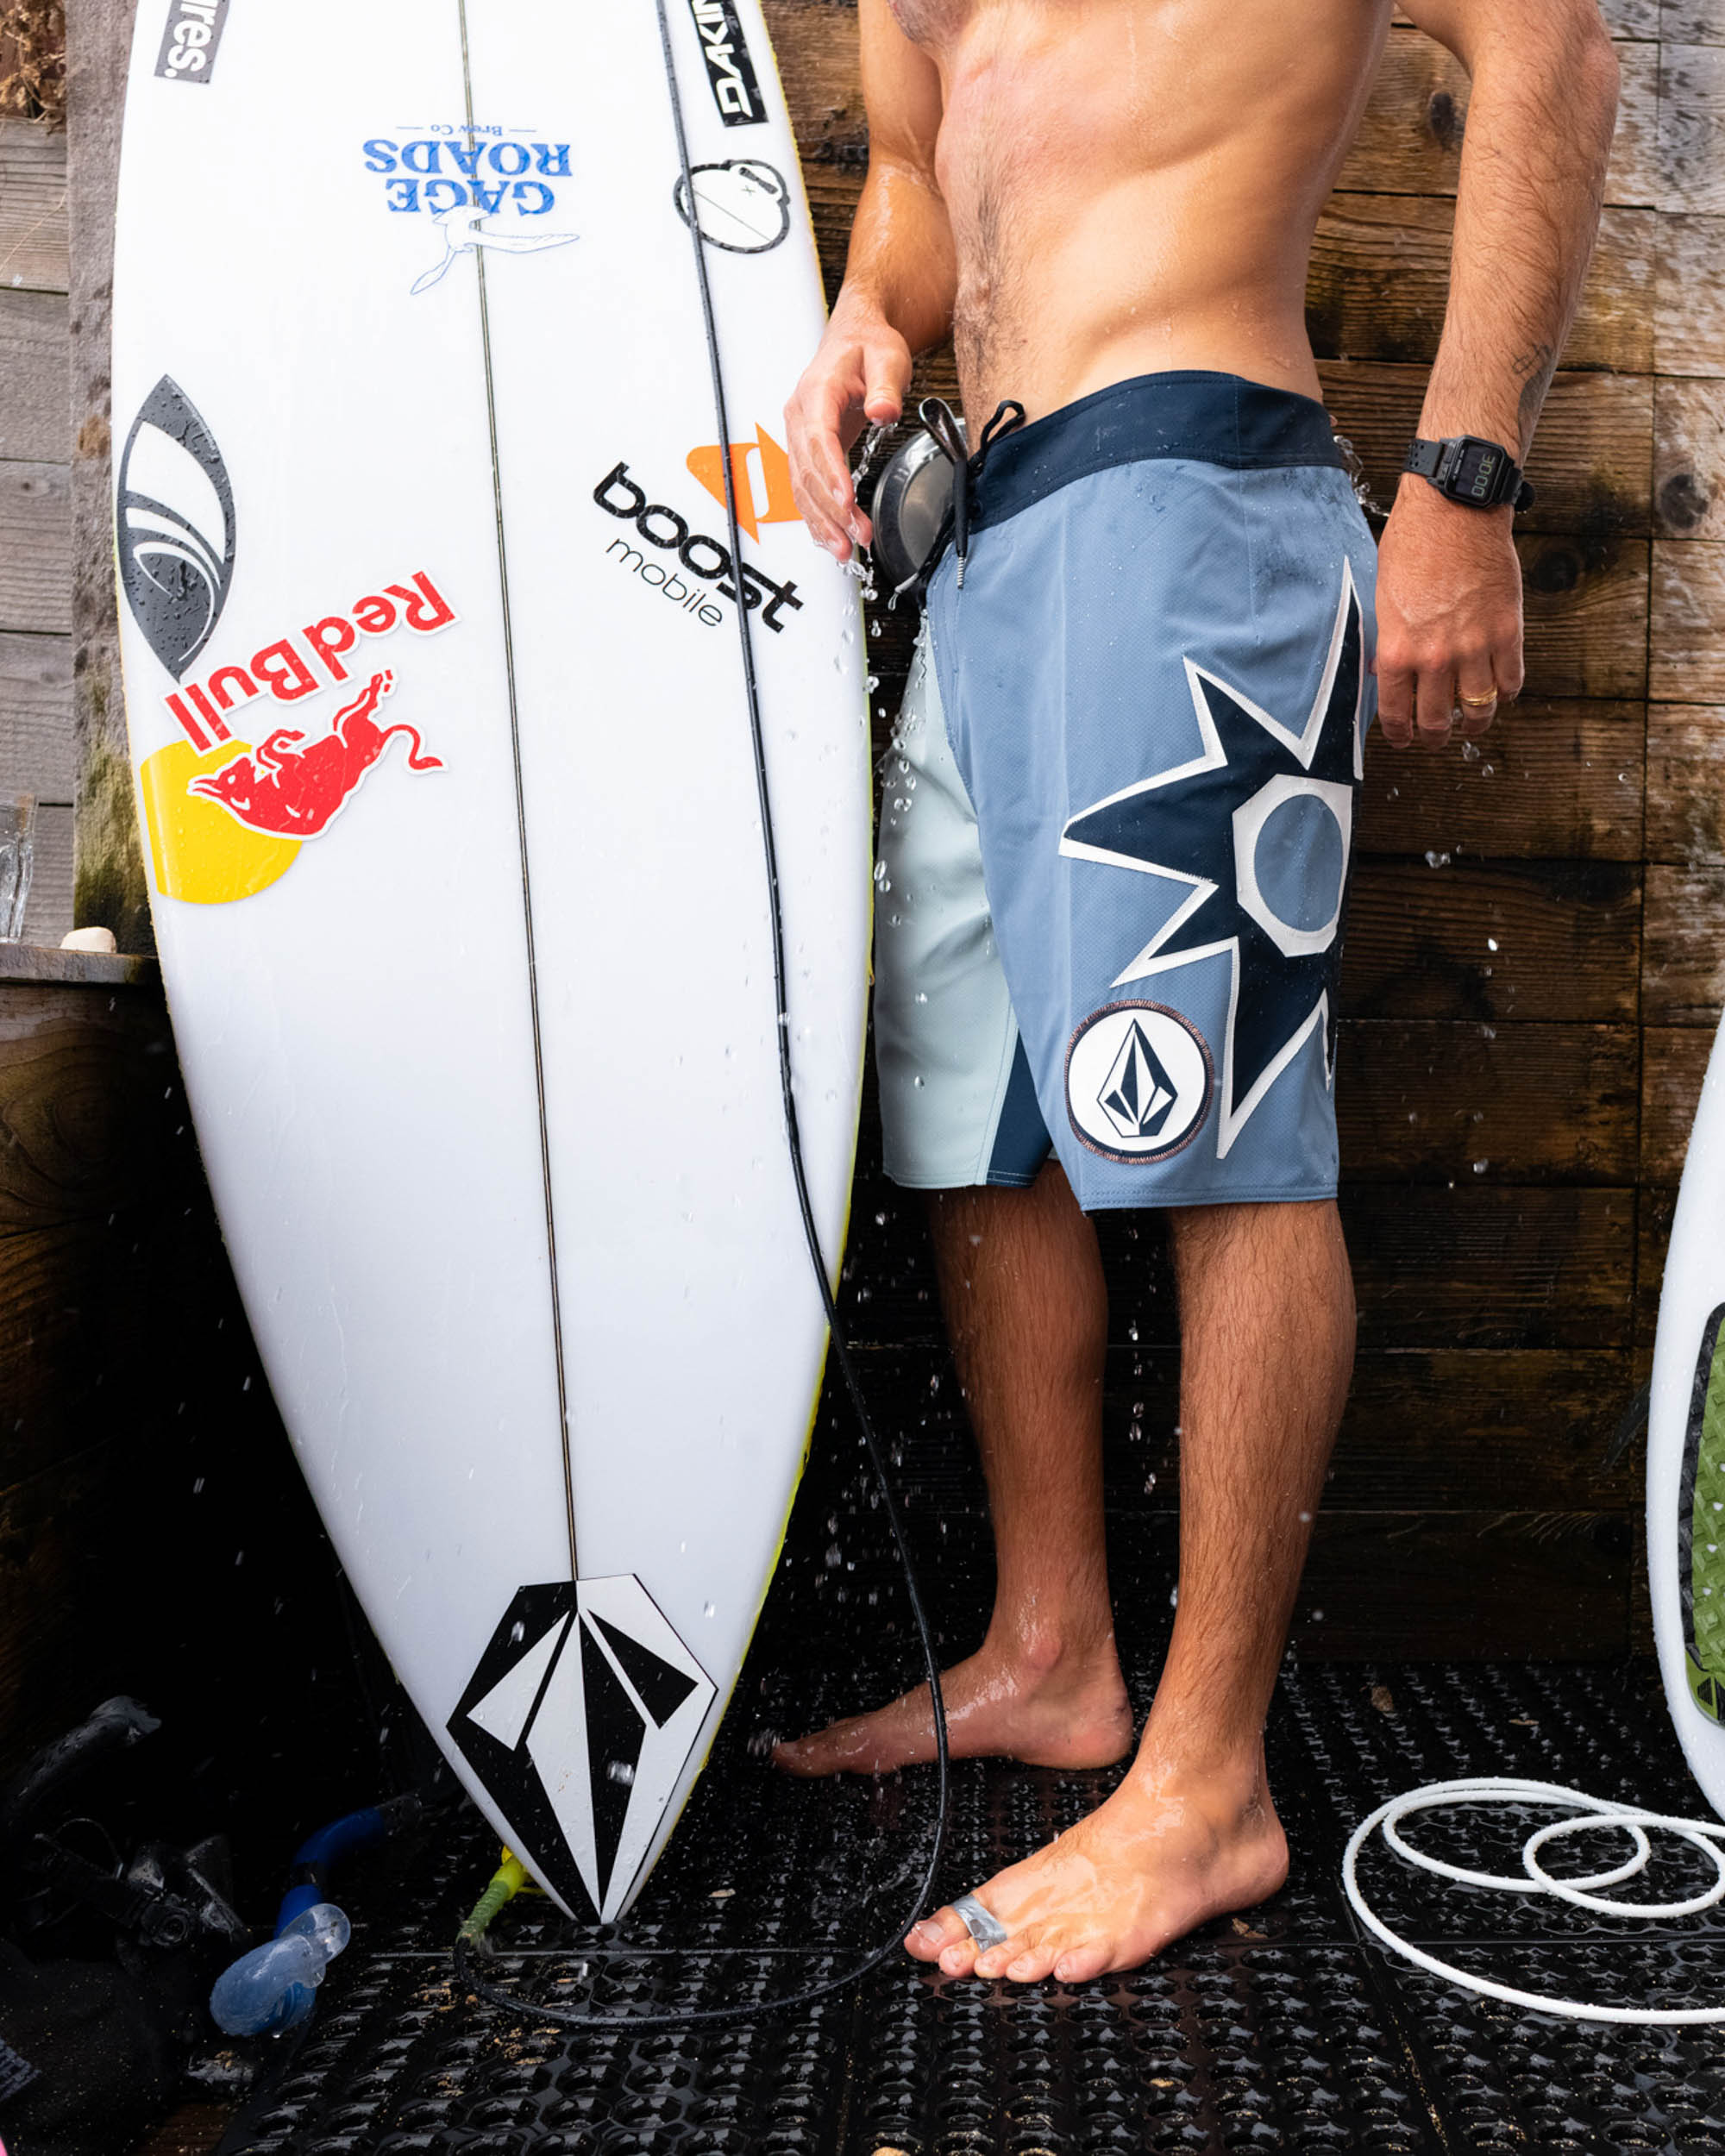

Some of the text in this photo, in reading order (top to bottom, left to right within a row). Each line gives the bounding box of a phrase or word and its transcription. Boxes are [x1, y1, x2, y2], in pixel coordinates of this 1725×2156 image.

[430, 124, 503, 137] Brew Co
[362, 139, 574, 176] ROADS
[386, 179, 555, 216] GAGE
[593, 460, 804, 634] boost
[605, 537, 724, 627] mobile
